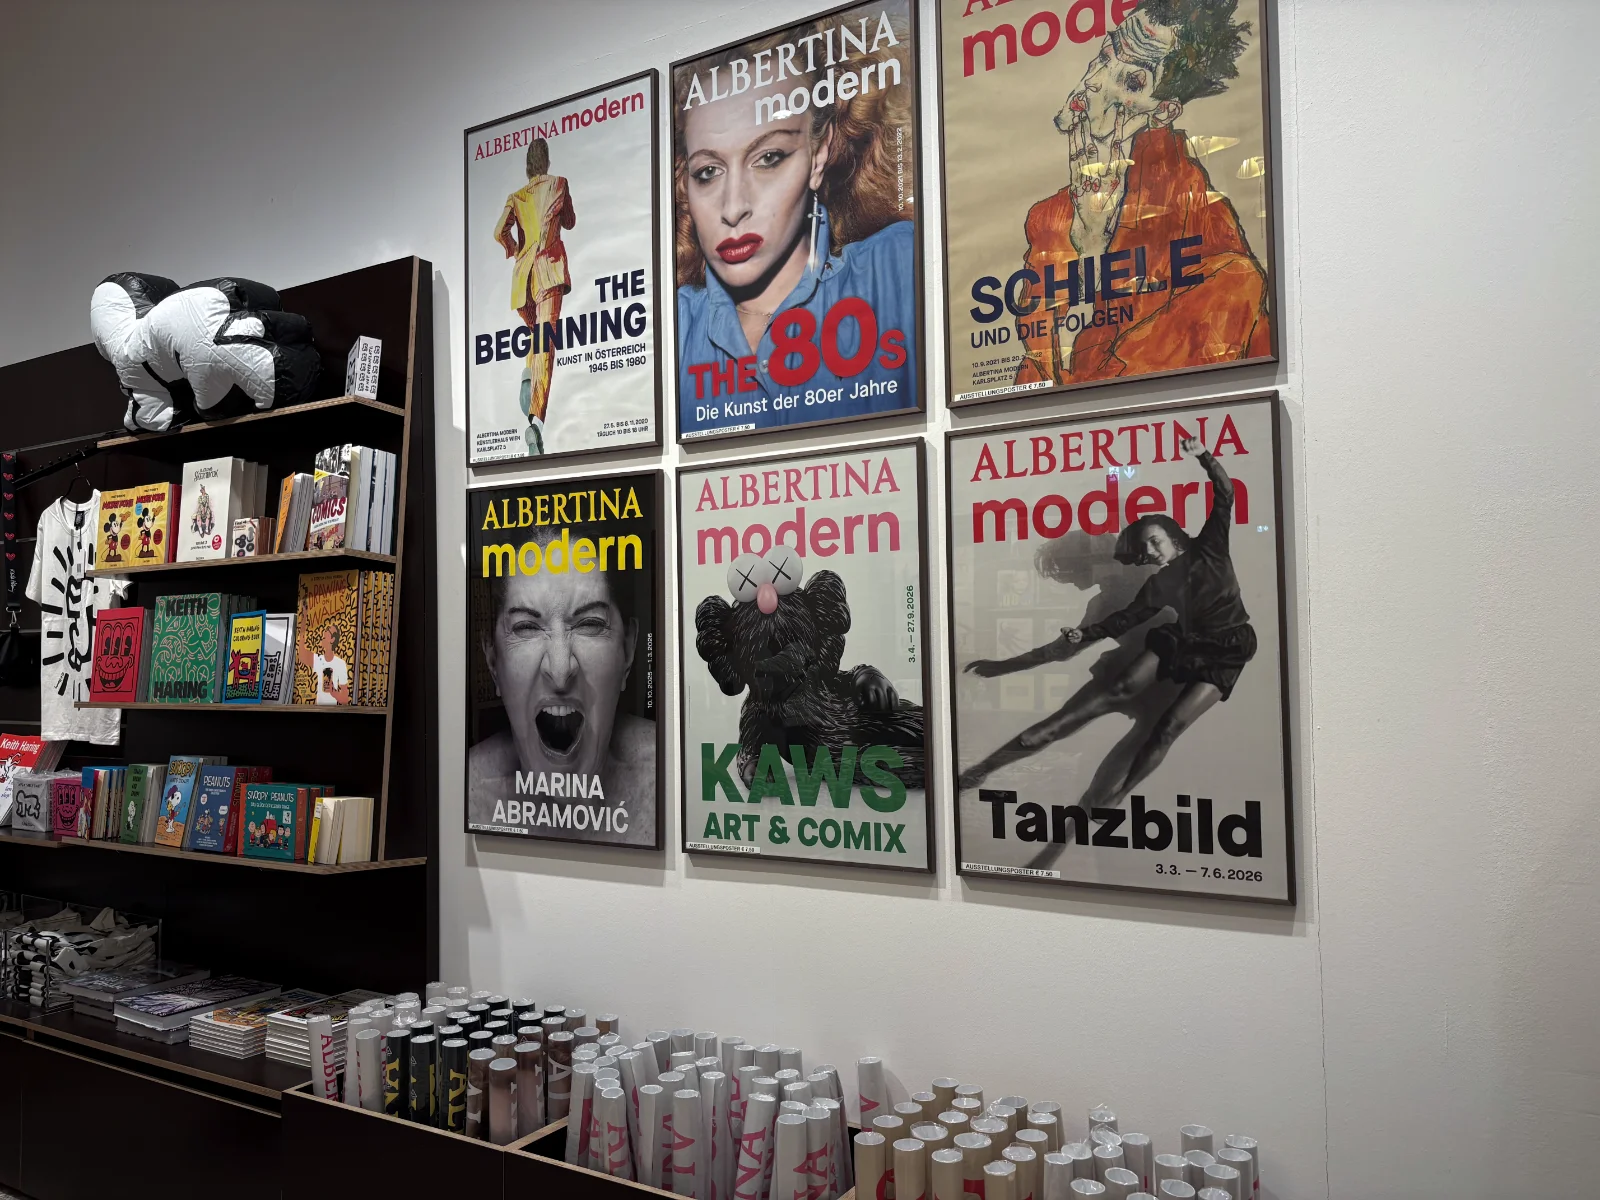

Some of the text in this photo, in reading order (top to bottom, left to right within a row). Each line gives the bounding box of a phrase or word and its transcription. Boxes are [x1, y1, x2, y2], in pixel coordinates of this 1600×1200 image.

[682, 10, 900, 111] ALBERTINA
[755, 58, 901, 125] modern
[474, 92, 644, 161] ALBERTINA modern
[595, 268, 645, 303] THE
[969, 234, 1205, 324] SCHIELE
[475, 302, 647, 365] BEGINNING
[971, 303, 1134, 349] UND DIE FOLGEN
[557, 343, 646, 367] KUNST IN ÖSTERREICH
[588, 355, 646, 373] 1945 BIS 1980
[688, 297, 907, 399] THE 80s
[972, 359, 1000, 369] 10.9.2021
[972, 364, 1029, 378] ALBERTINA MODERN
[972, 375, 1008, 386] KARLSPLATZ
[696, 380, 898, 422] Die Kunst der 80er Jahre
[959, 384, 1027, 400] AUSSTELLUNGSPOSTER
[970, 413, 1249, 482] ALBERTINA
[695, 456, 900, 512] ALBERTINA
[312, 496, 346, 524] COMICS
[481, 486, 644, 530] ALBERTINA
[972, 473, 1249, 544] modern
[482, 528, 643, 578] modern
[697, 507, 900, 565] modern
[166, 598, 208, 617] KEITH
[308, 579, 346, 610] DRAWING
[310, 595, 344, 628] WALLS
[906, 585, 915, 633] 27.9.2026
[908, 644, 916, 663] 3.4.
[154, 680, 208, 698] HARING
[0, 738, 41, 755] Keith Haring
[203, 775, 231, 788] PEANUTS
[515, 770, 605, 800] MARINA
[701, 742, 907, 813] KAWS
[247, 790, 295, 803] SNOOPY PEANUTS
[491, 799, 629, 834] ABRAMOVIĆ
[703, 812, 907, 854] ART & COMIX
[978, 788, 1263, 858] Tanzbild
[965, 863, 1034, 875] AUSSTELLUNGSPOSTER
[1155, 863, 1181, 876] 3.3.
[1200, 866, 1263, 882] 7.6.2026
